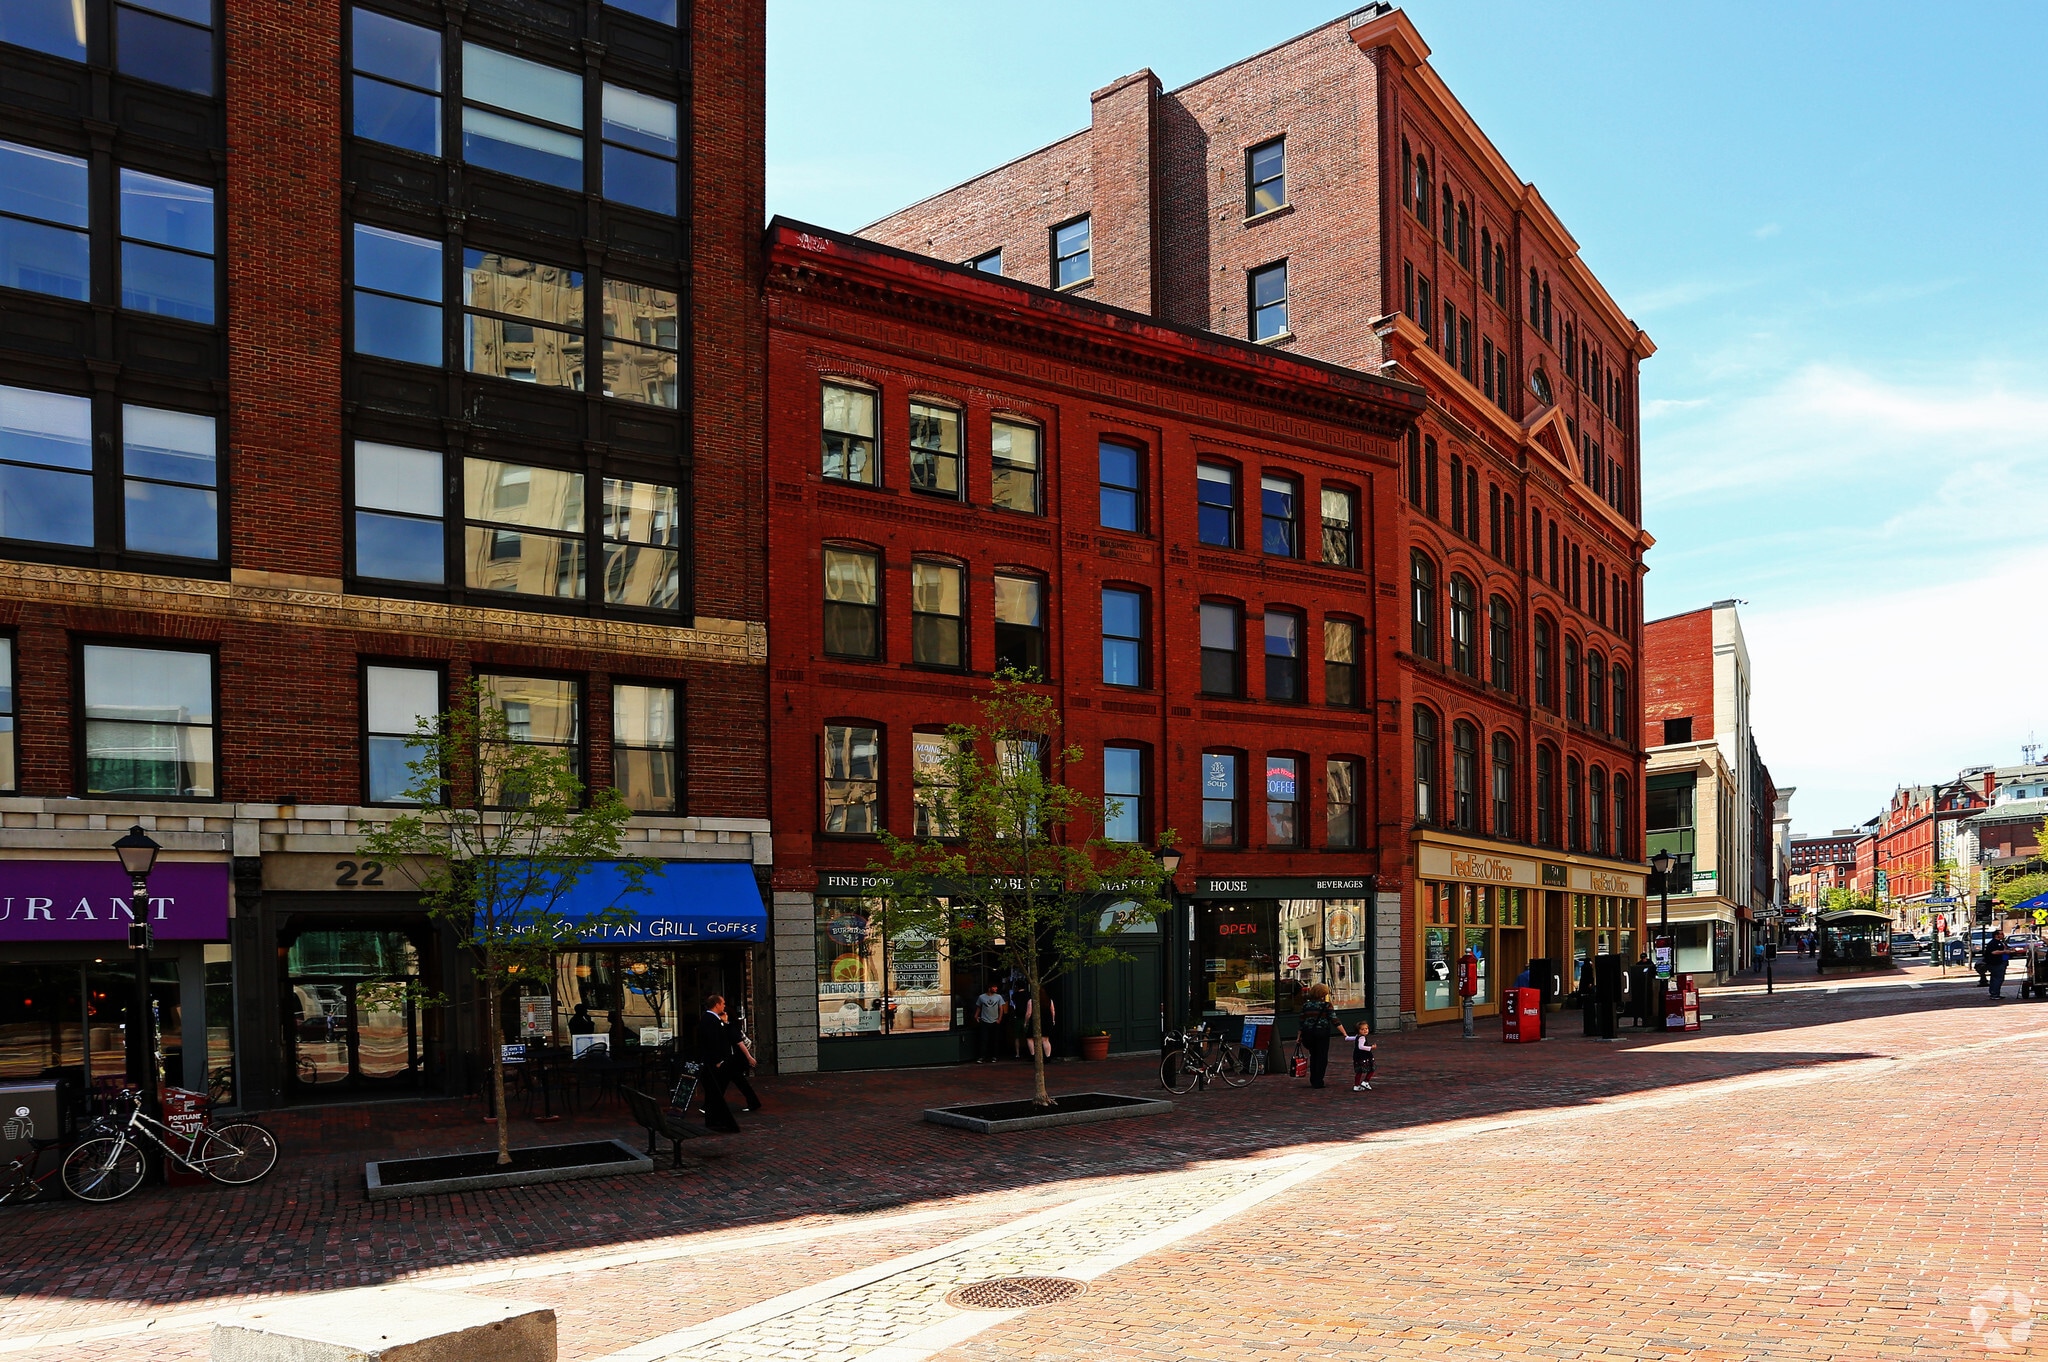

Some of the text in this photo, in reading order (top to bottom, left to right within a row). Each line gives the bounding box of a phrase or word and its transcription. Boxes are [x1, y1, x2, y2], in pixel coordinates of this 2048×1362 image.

[1207, 780, 1228, 792] soup
[1450, 851, 1512, 882] FedEx Office
[336, 861, 383, 886] 22
[828, 876, 895, 888] FINE FOOD
[1209, 880, 1248, 892] HOUSE
[1316, 880, 1364, 889] BEVERAGES
[1591, 870, 1629, 893] FedEx Office
[649, 917, 699, 937] GRILL
[1218, 923, 1258, 936] OPEN
[822, 983, 846, 994] MAINE
